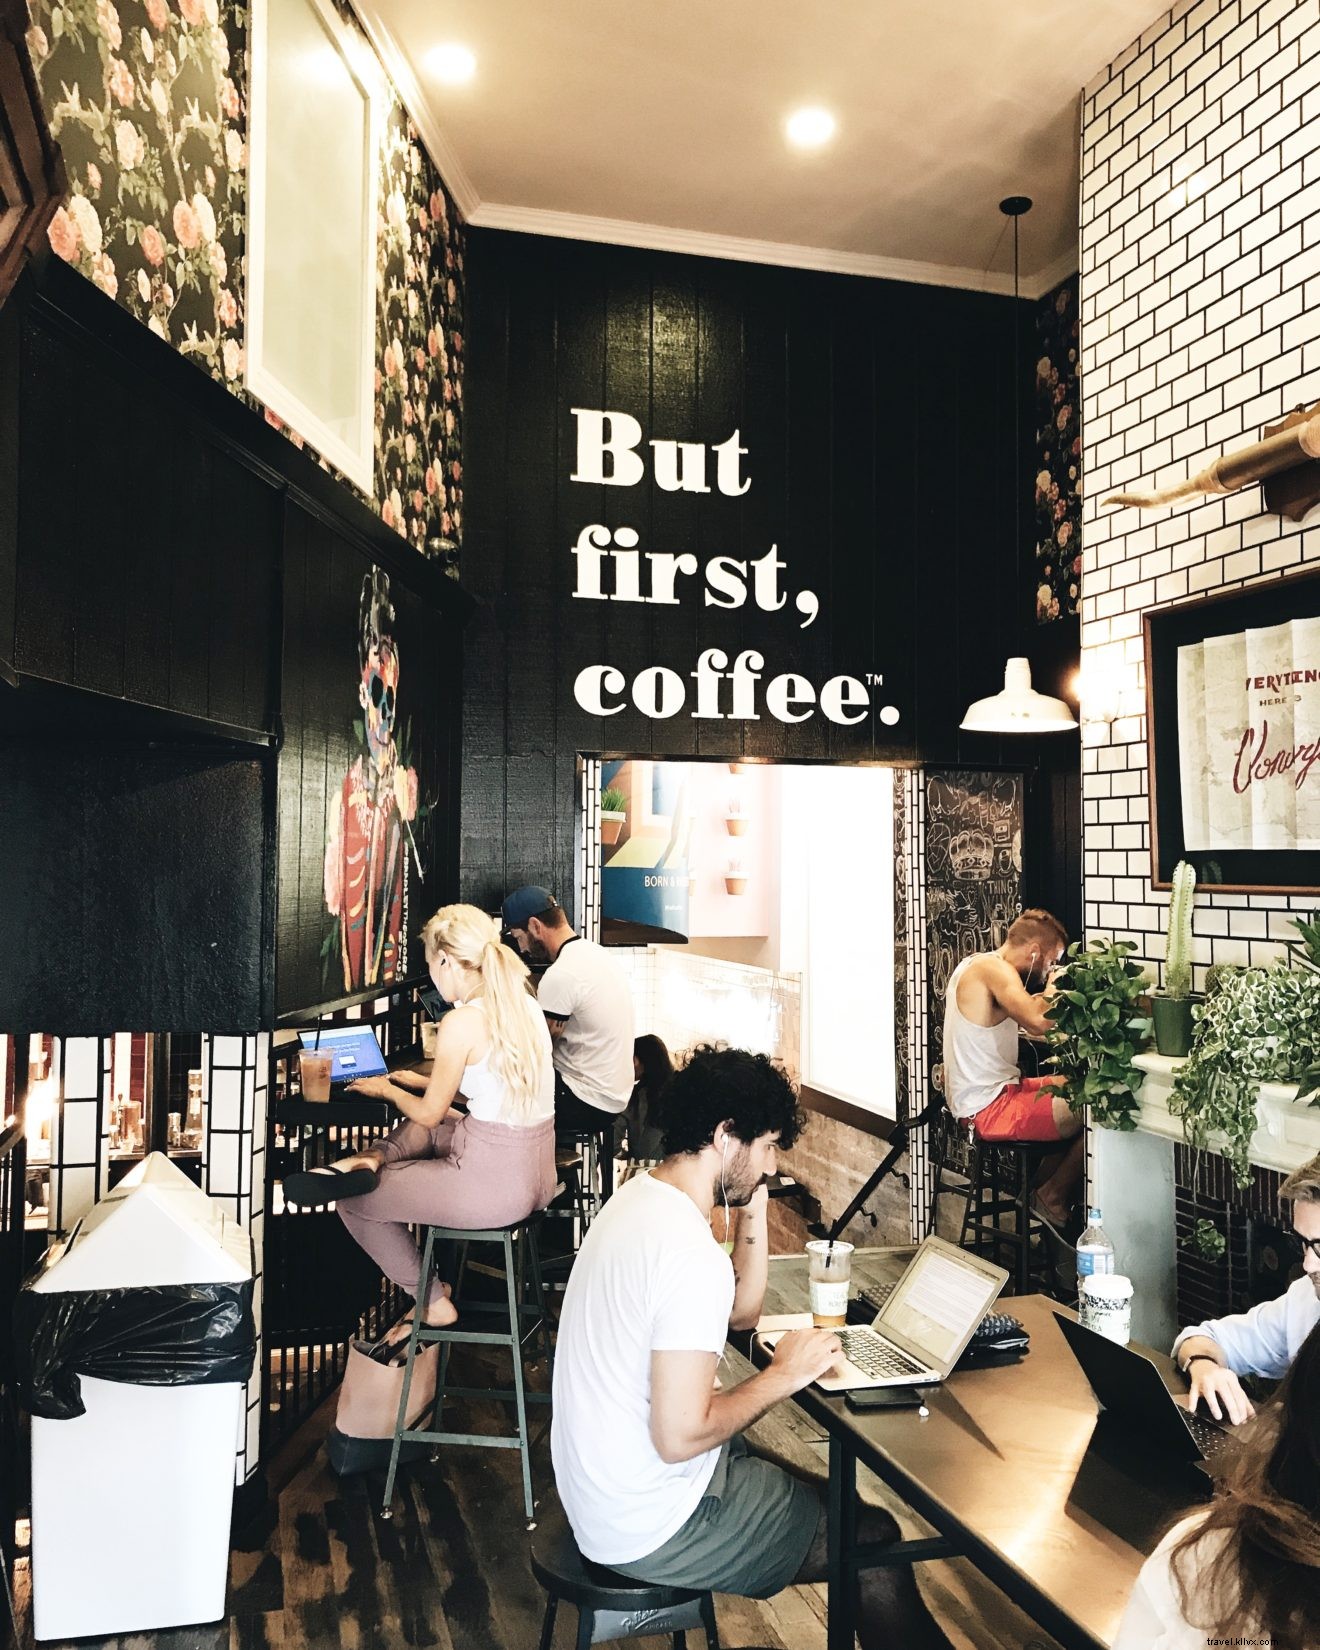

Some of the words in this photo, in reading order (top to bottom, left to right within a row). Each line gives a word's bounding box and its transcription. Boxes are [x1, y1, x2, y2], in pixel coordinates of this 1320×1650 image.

[570, 408, 751, 497] But
[570, 524, 819, 629] first,
[1259, 697, 1288, 707] HERE
[644, 875, 669, 888] BORN
